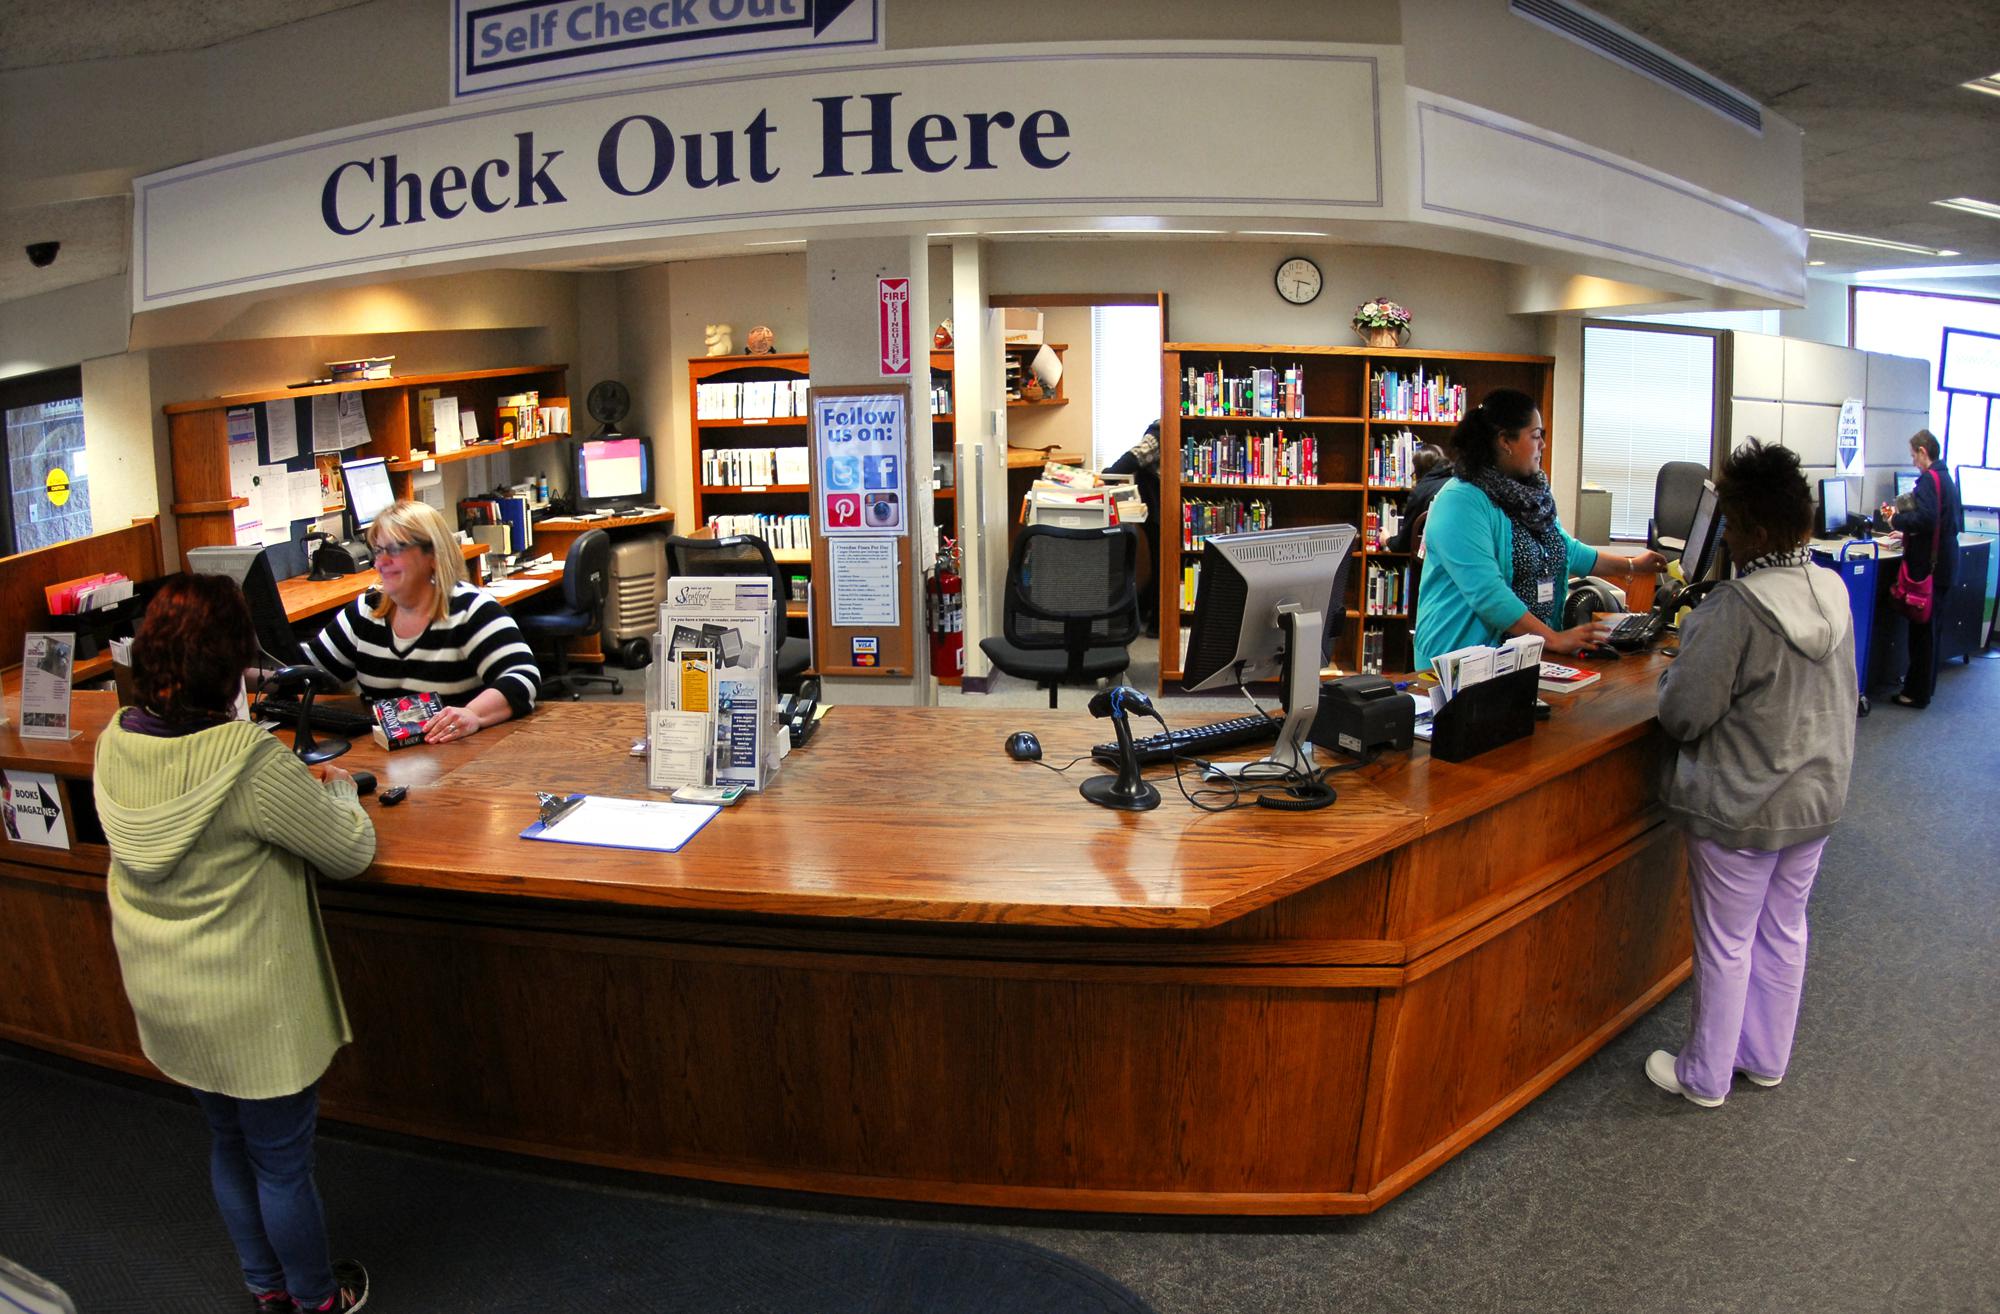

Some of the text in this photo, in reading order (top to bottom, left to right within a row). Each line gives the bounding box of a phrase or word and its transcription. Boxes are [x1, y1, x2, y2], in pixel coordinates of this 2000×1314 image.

[480, 10, 558, 59] Self
[566, 0, 699, 42] Check
[321, 91, 1072, 236] Check Out Here
[883, 291, 906, 301] FIRE
[823, 407, 896, 426] Follow
[1842, 416, 1856, 425] heck
[828, 427, 893, 442] us on:
[1841, 427, 1858, 435] tation
[14, 789, 39, 800] BOOKS
[16, 804, 57, 817] MAGAZINES
